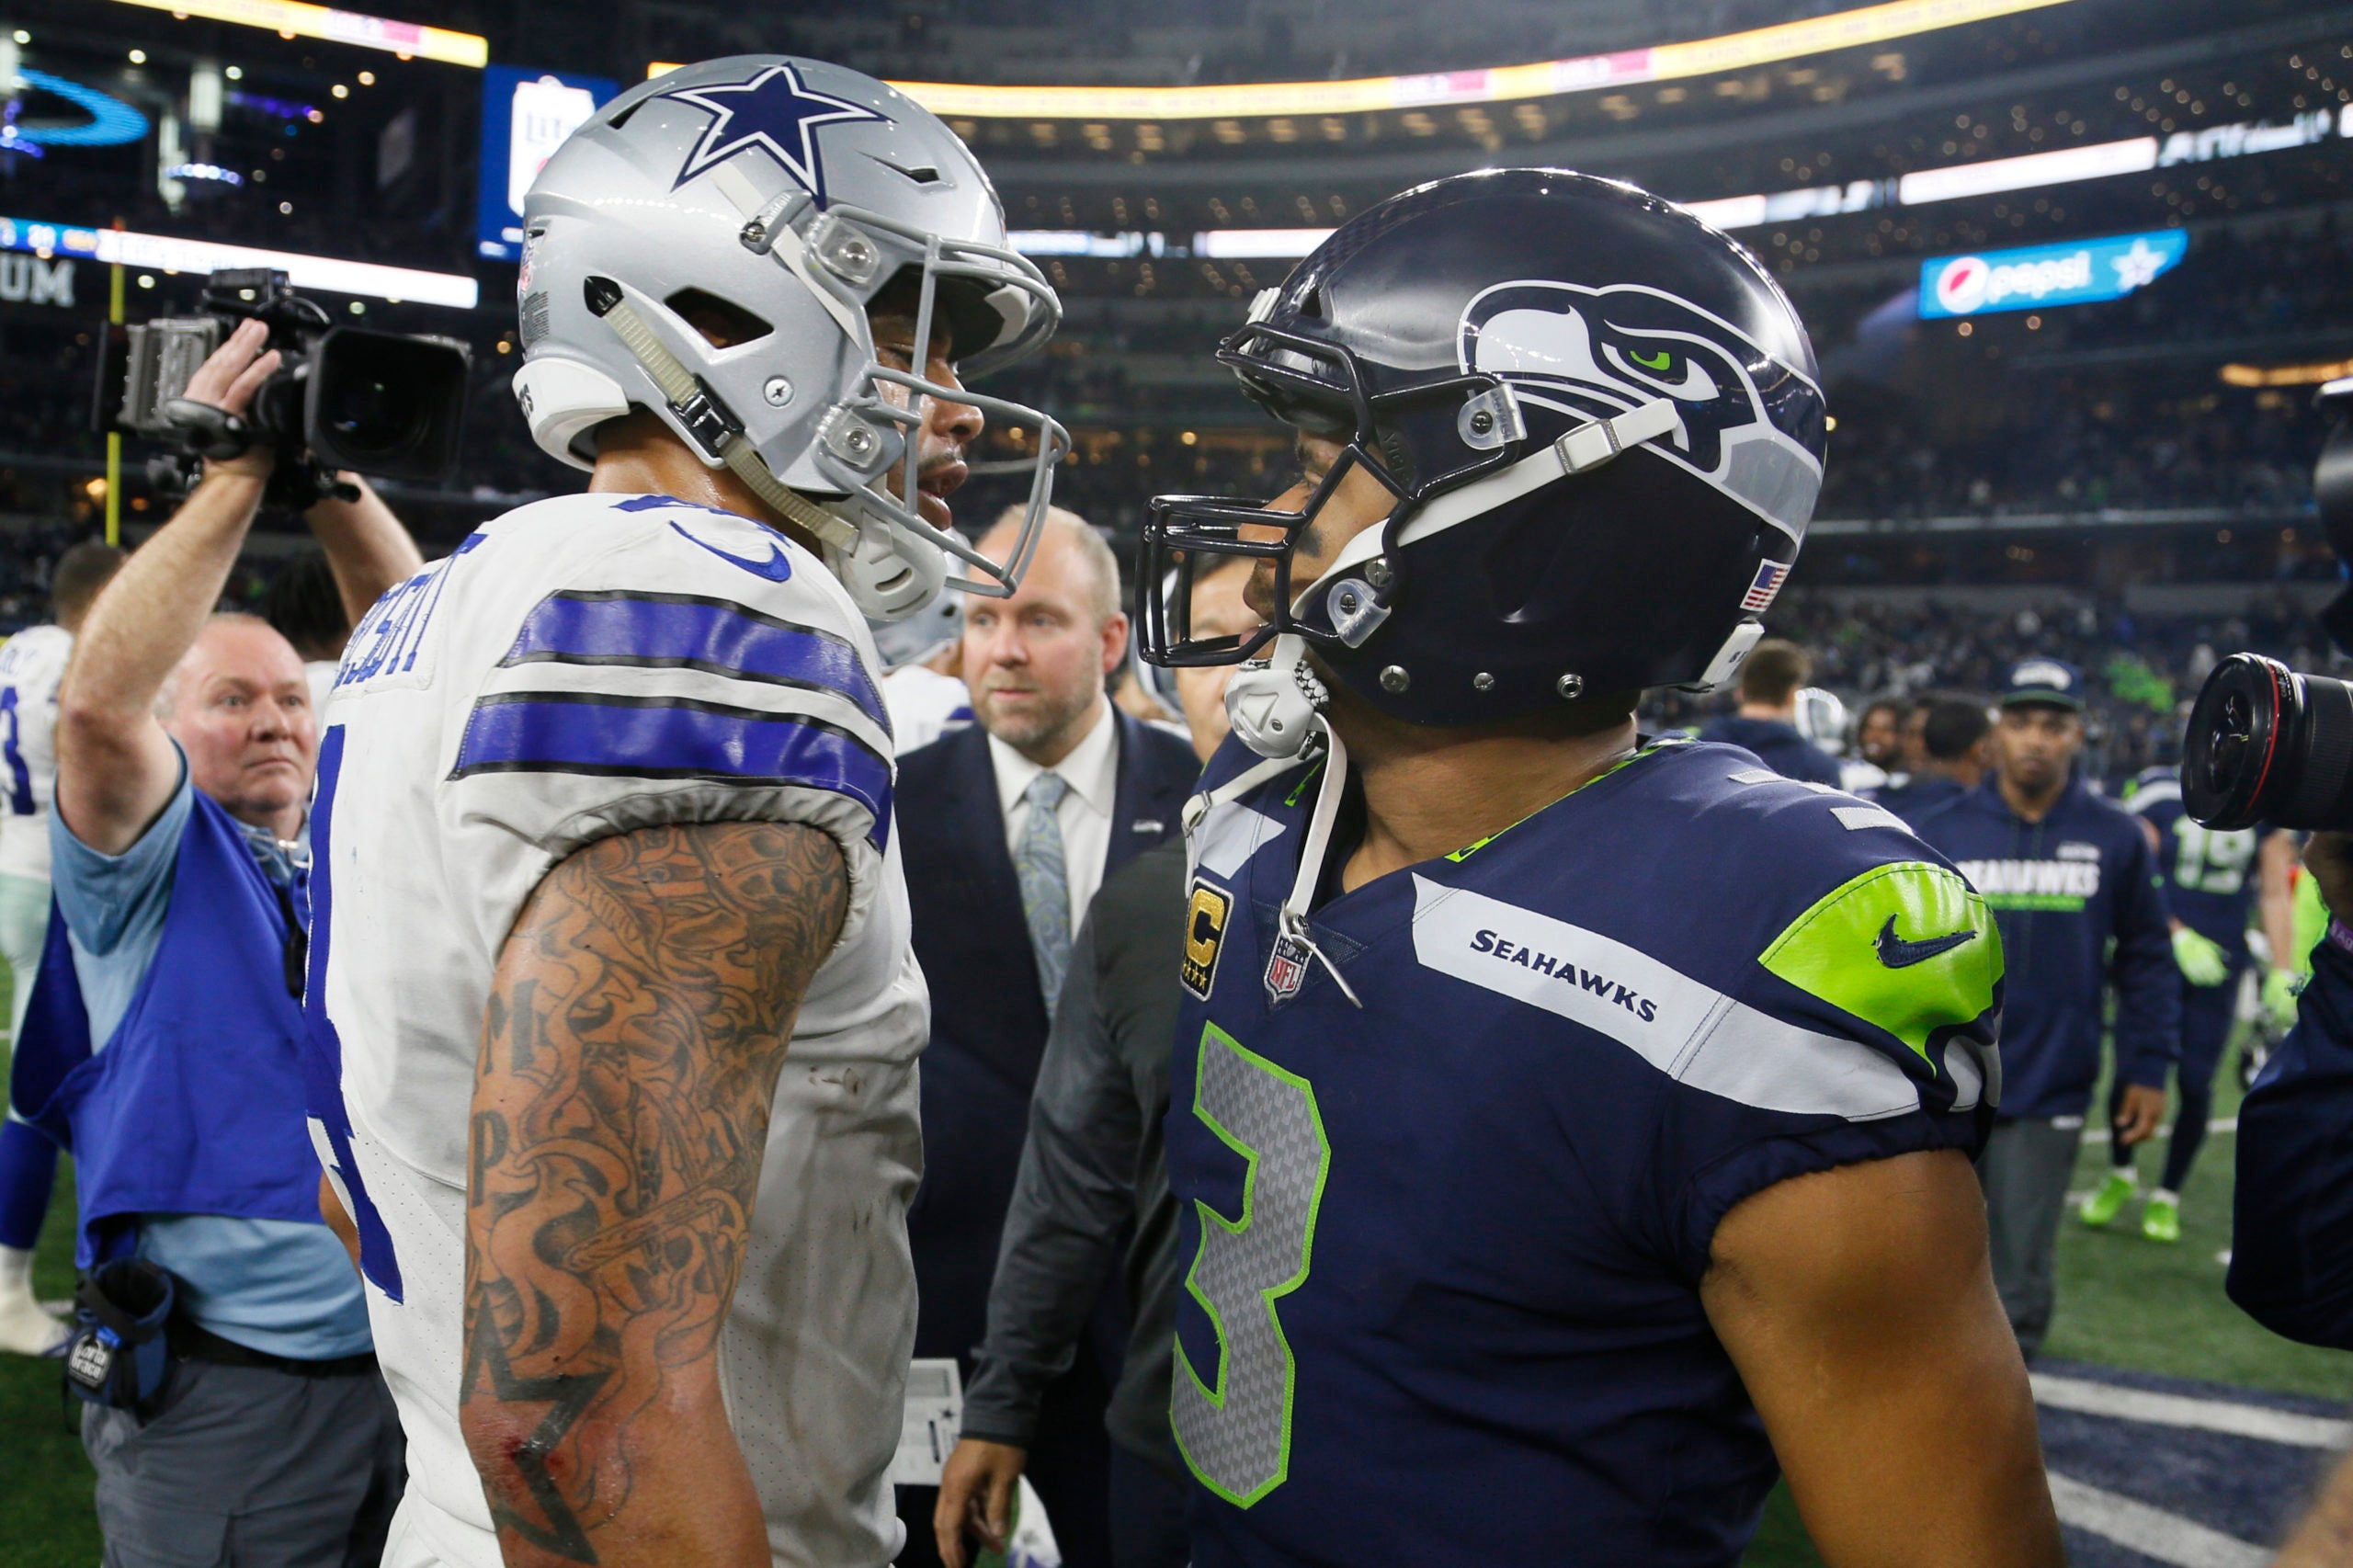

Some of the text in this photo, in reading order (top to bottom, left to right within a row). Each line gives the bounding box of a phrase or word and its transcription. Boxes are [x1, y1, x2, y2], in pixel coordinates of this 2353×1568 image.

[1987, 250, 2090, 304] pepsi
[2172, 814, 2256, 895] 19
[1186, 888, 1225, 968] C
[1269, 956, 1298, 991] NFL
[1169, 1019, 1332, 1510] 3
